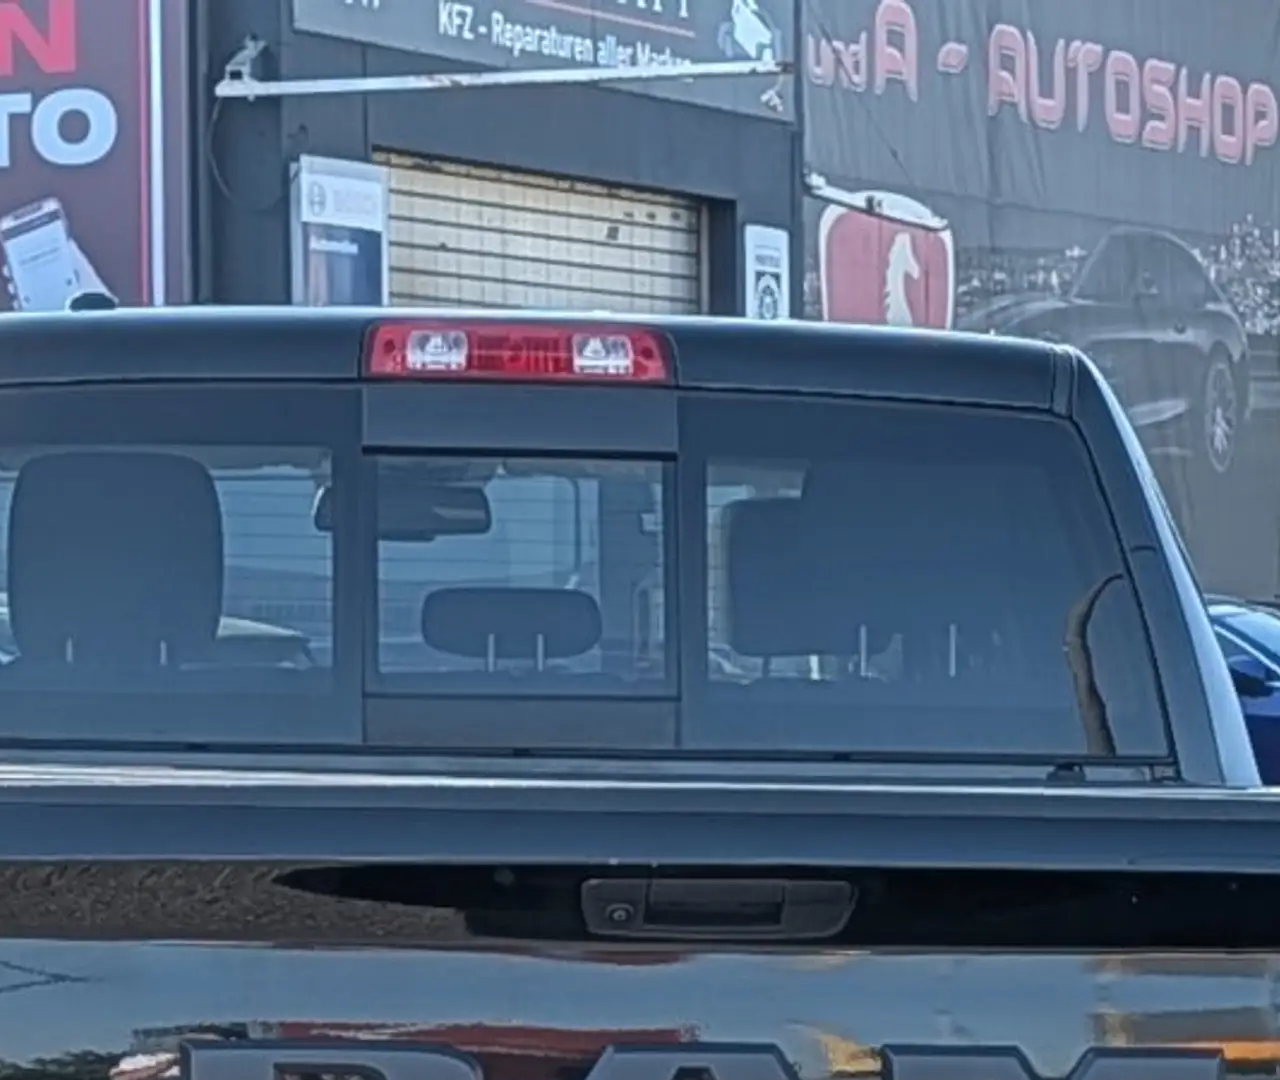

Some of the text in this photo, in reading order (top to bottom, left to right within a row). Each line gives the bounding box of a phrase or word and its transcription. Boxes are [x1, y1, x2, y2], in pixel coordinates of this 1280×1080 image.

[437, 2, 475, 40] KFZ
[490, 12, 594, 62] Reparaturen
[597, 34, 634, 69] aller
[988, 23, 1279, 166] AUTOSHOP
